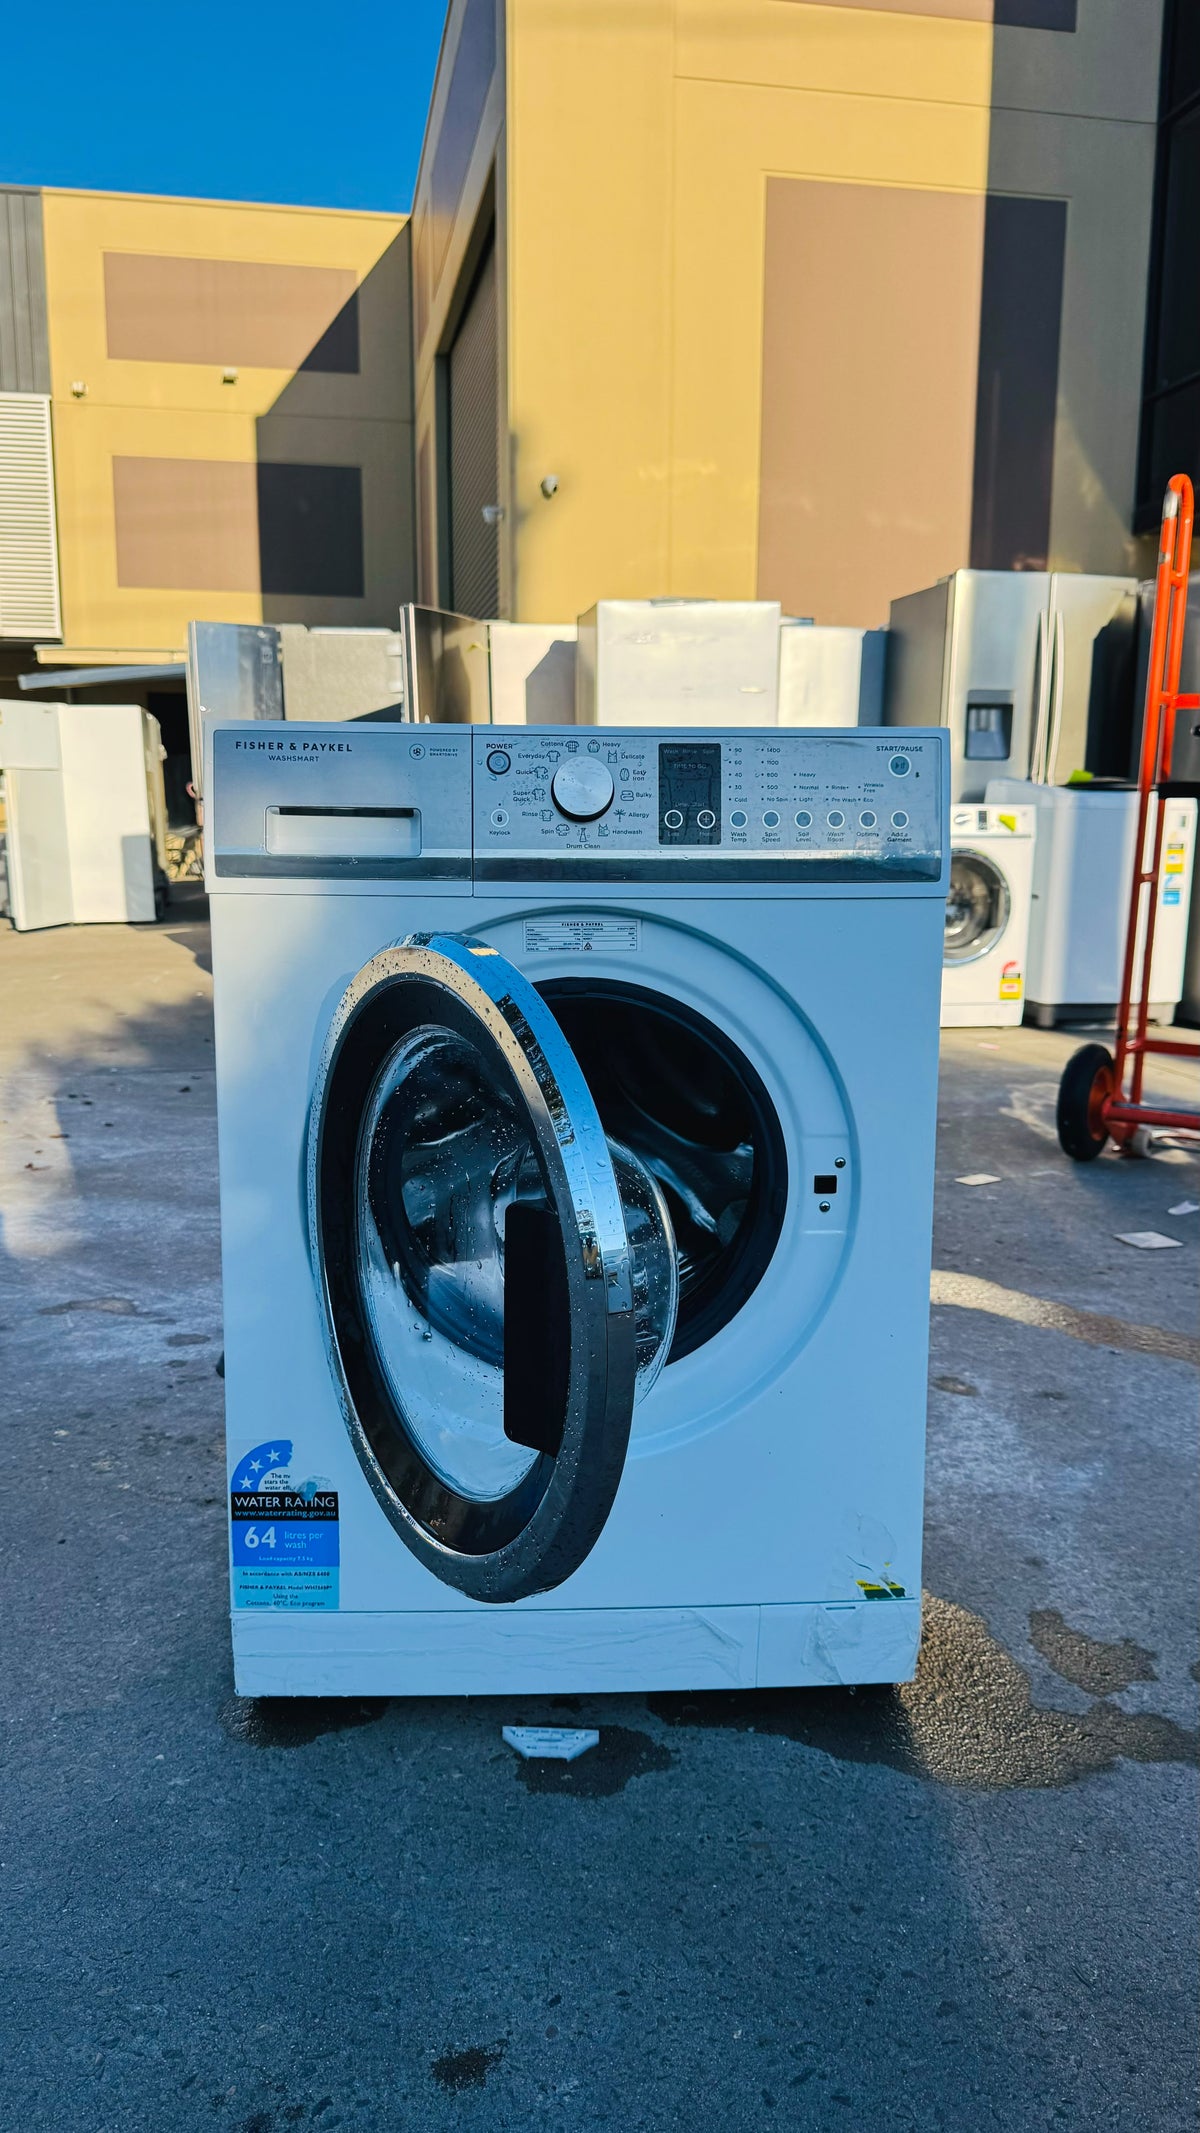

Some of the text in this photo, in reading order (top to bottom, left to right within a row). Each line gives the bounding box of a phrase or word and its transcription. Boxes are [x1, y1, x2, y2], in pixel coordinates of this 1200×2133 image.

[235, 741, 353, 752] FISHER & PAYKEL
[235, 1497, 281, 1507] WATER
[235, 1510, 336, 1518] www.waterrating.gov.au
[245, 1526, 276, 1549] 64
[284, 1531, 323, 1541] litres per
